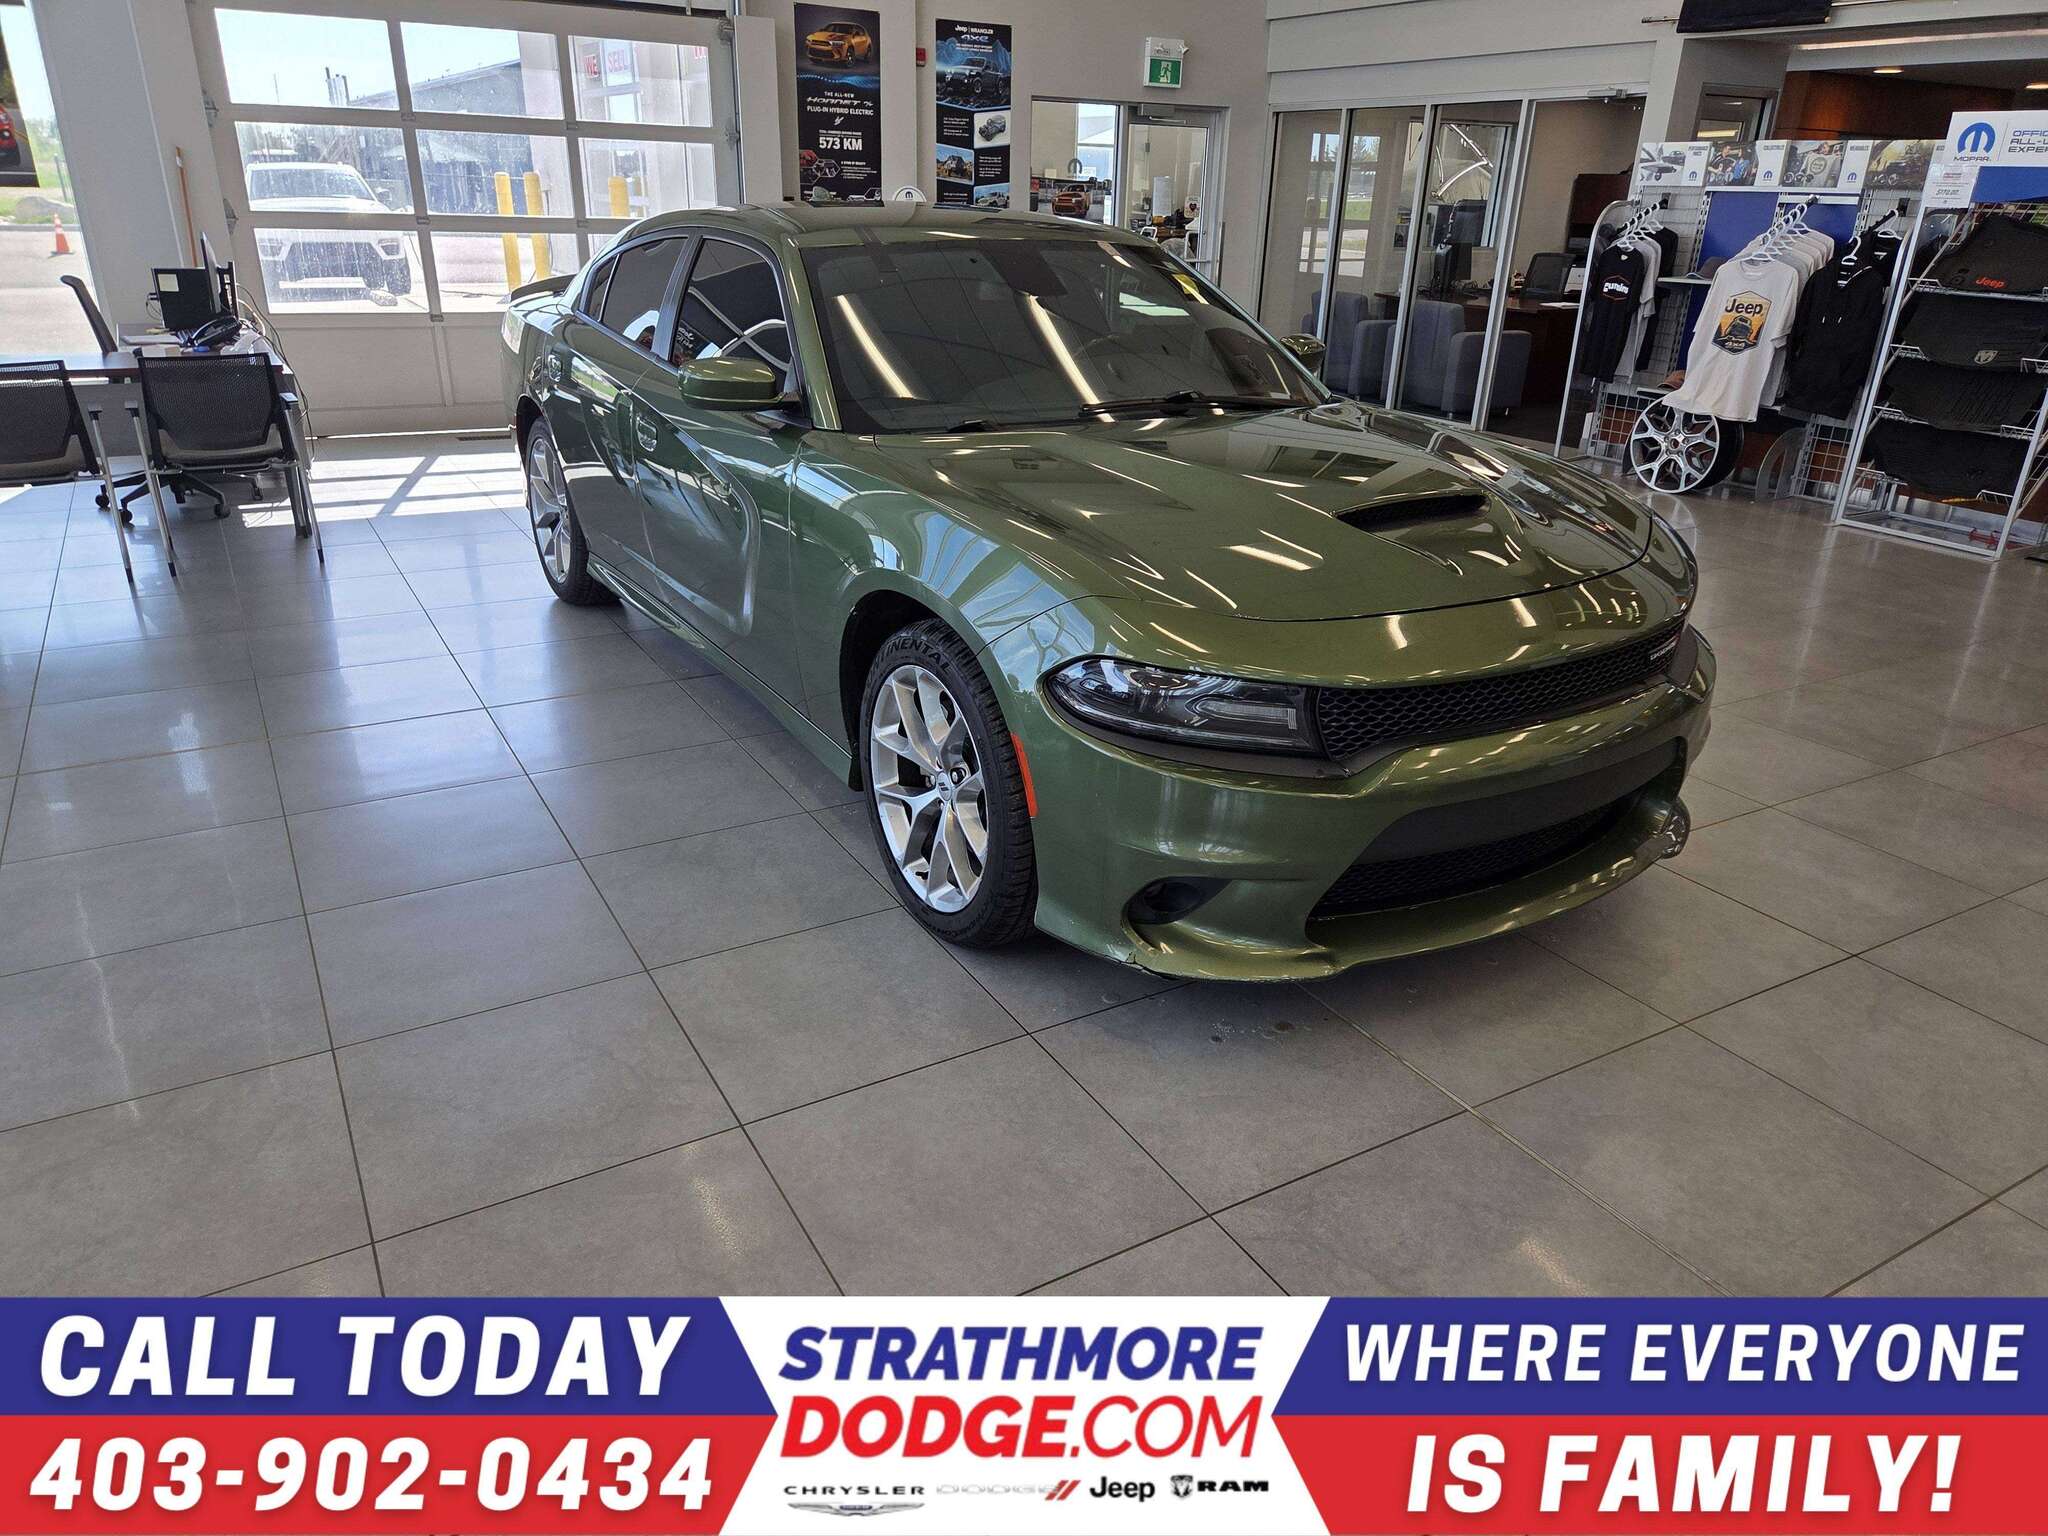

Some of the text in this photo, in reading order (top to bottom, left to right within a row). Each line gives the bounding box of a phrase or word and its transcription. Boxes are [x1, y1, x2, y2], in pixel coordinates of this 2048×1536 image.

[954, 24, 968, 33] Jeep
[806, 105, 829, 113] PLUG-IN
[849, 108, 874, 116] ELECTRIC
[819, 136, 863, 151] 573 KM
[1975, 276, 2005, 289] Jeep
[1725, 298, 1763, 317] Jeep
